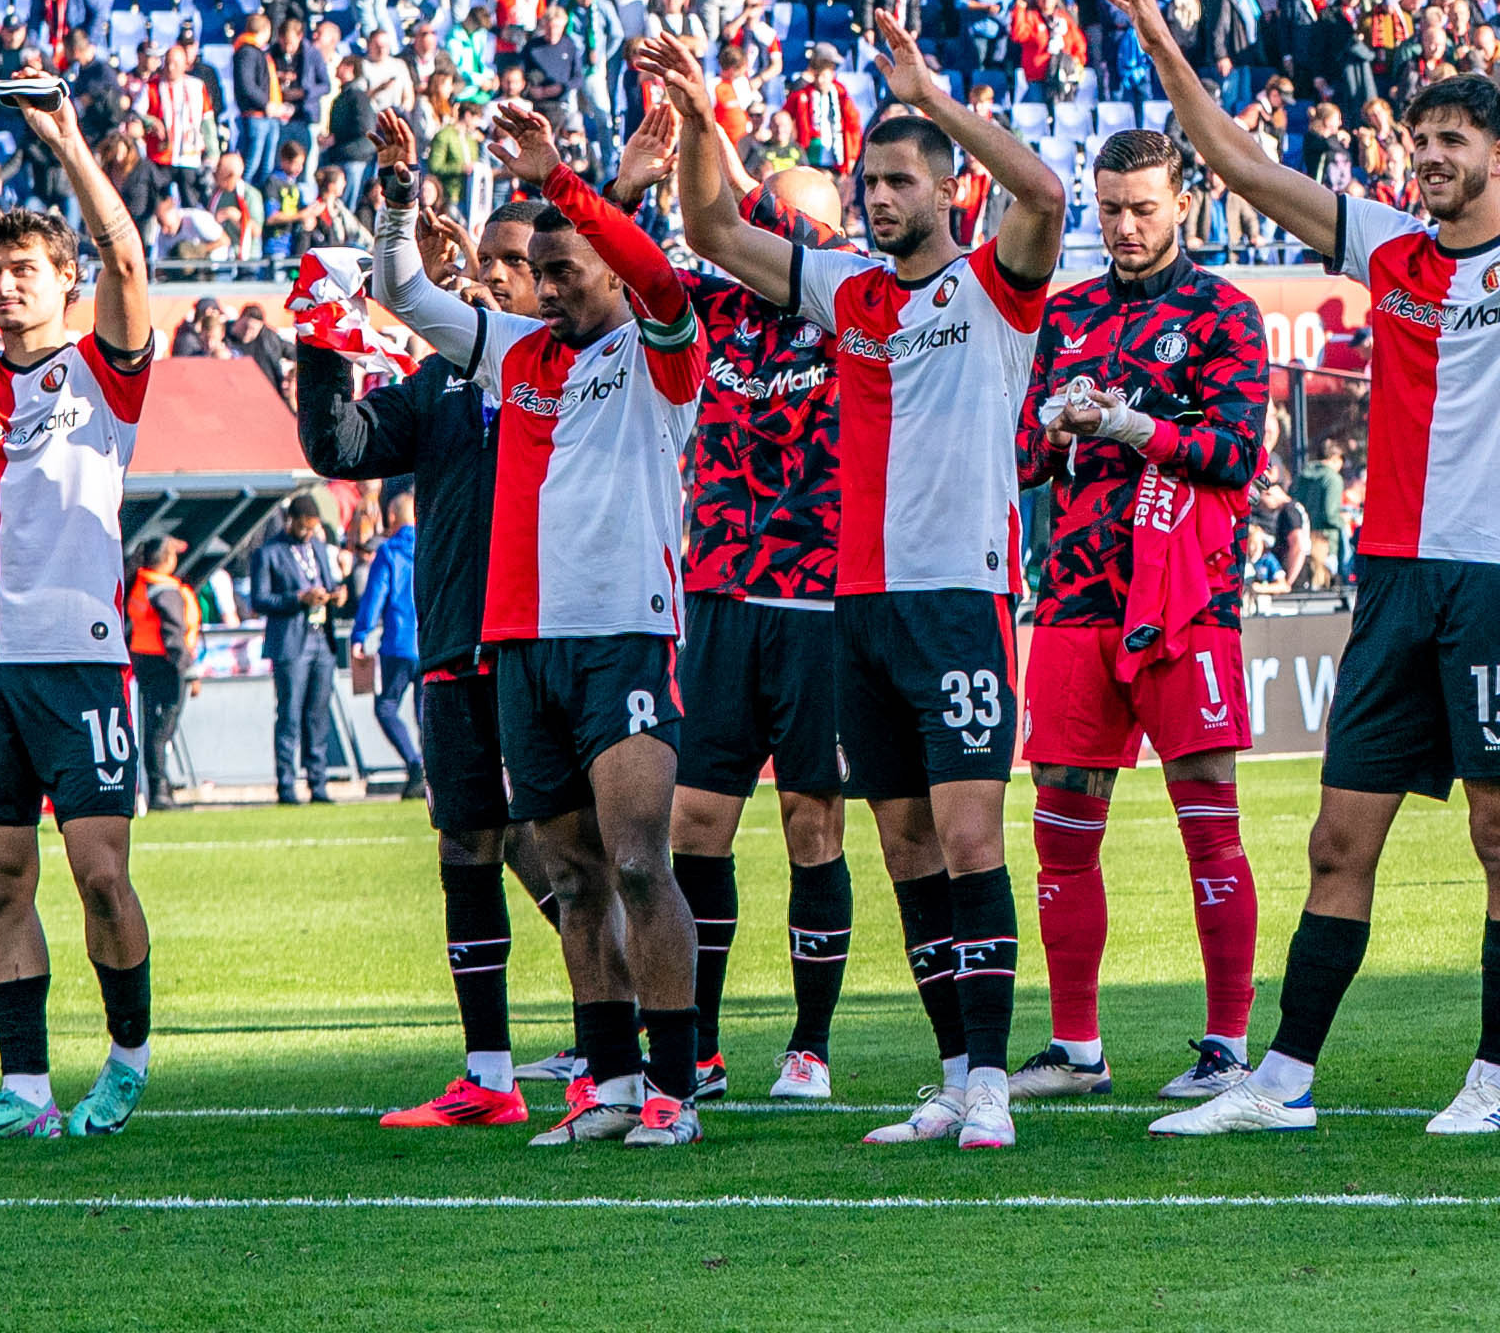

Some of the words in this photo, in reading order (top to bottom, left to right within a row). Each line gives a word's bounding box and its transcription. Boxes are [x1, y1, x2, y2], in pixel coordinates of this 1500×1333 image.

[1378, 289, 1441, 331] Media
[908, 320, 971, 357] Markt
[765, 362, 829, 398] Markt
[941, 669, 1002, 728] 33
[1195, 650, 1222, 704] 1
[81, 707, 130, 763] 16
[627, 690, 658, 735] 8
